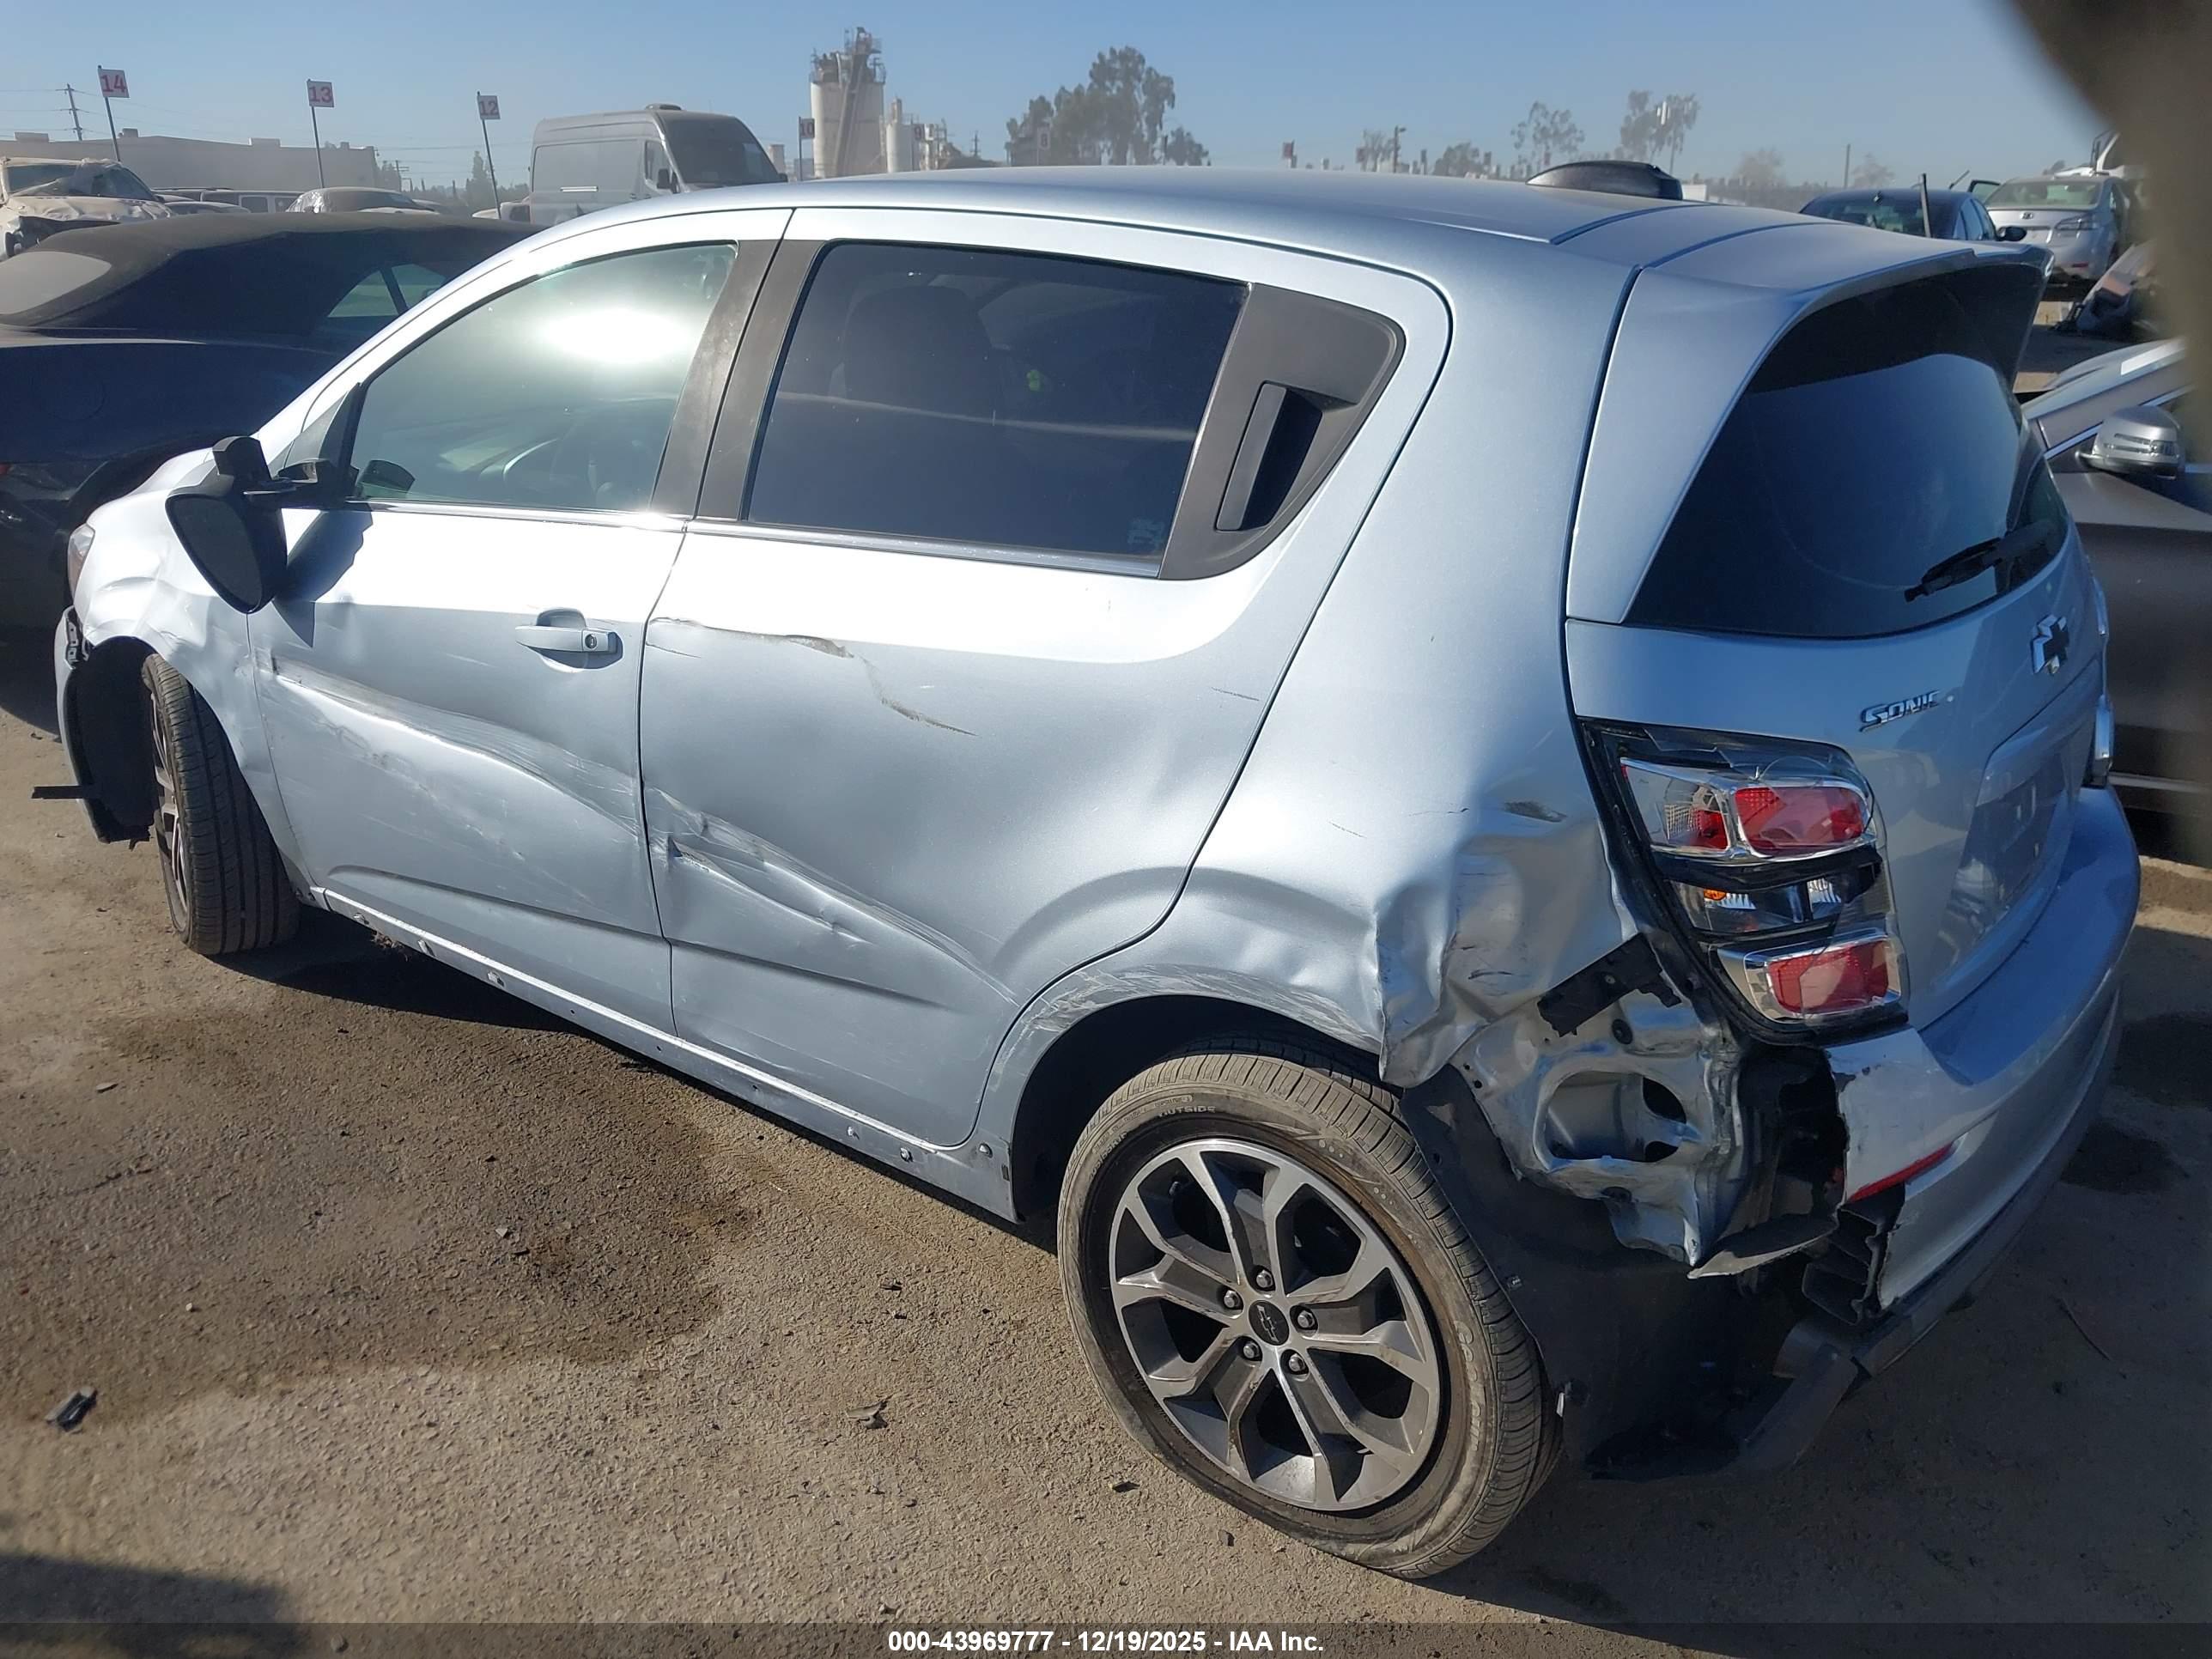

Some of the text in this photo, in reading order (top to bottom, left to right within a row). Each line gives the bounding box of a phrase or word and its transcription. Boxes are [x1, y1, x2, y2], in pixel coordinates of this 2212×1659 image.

[100, 74, 128, 94] 14
[308, 86, 332, 103] 13
[479, 100, 500, 117] 12
[1858, 690, 1941, 732] SONIC
